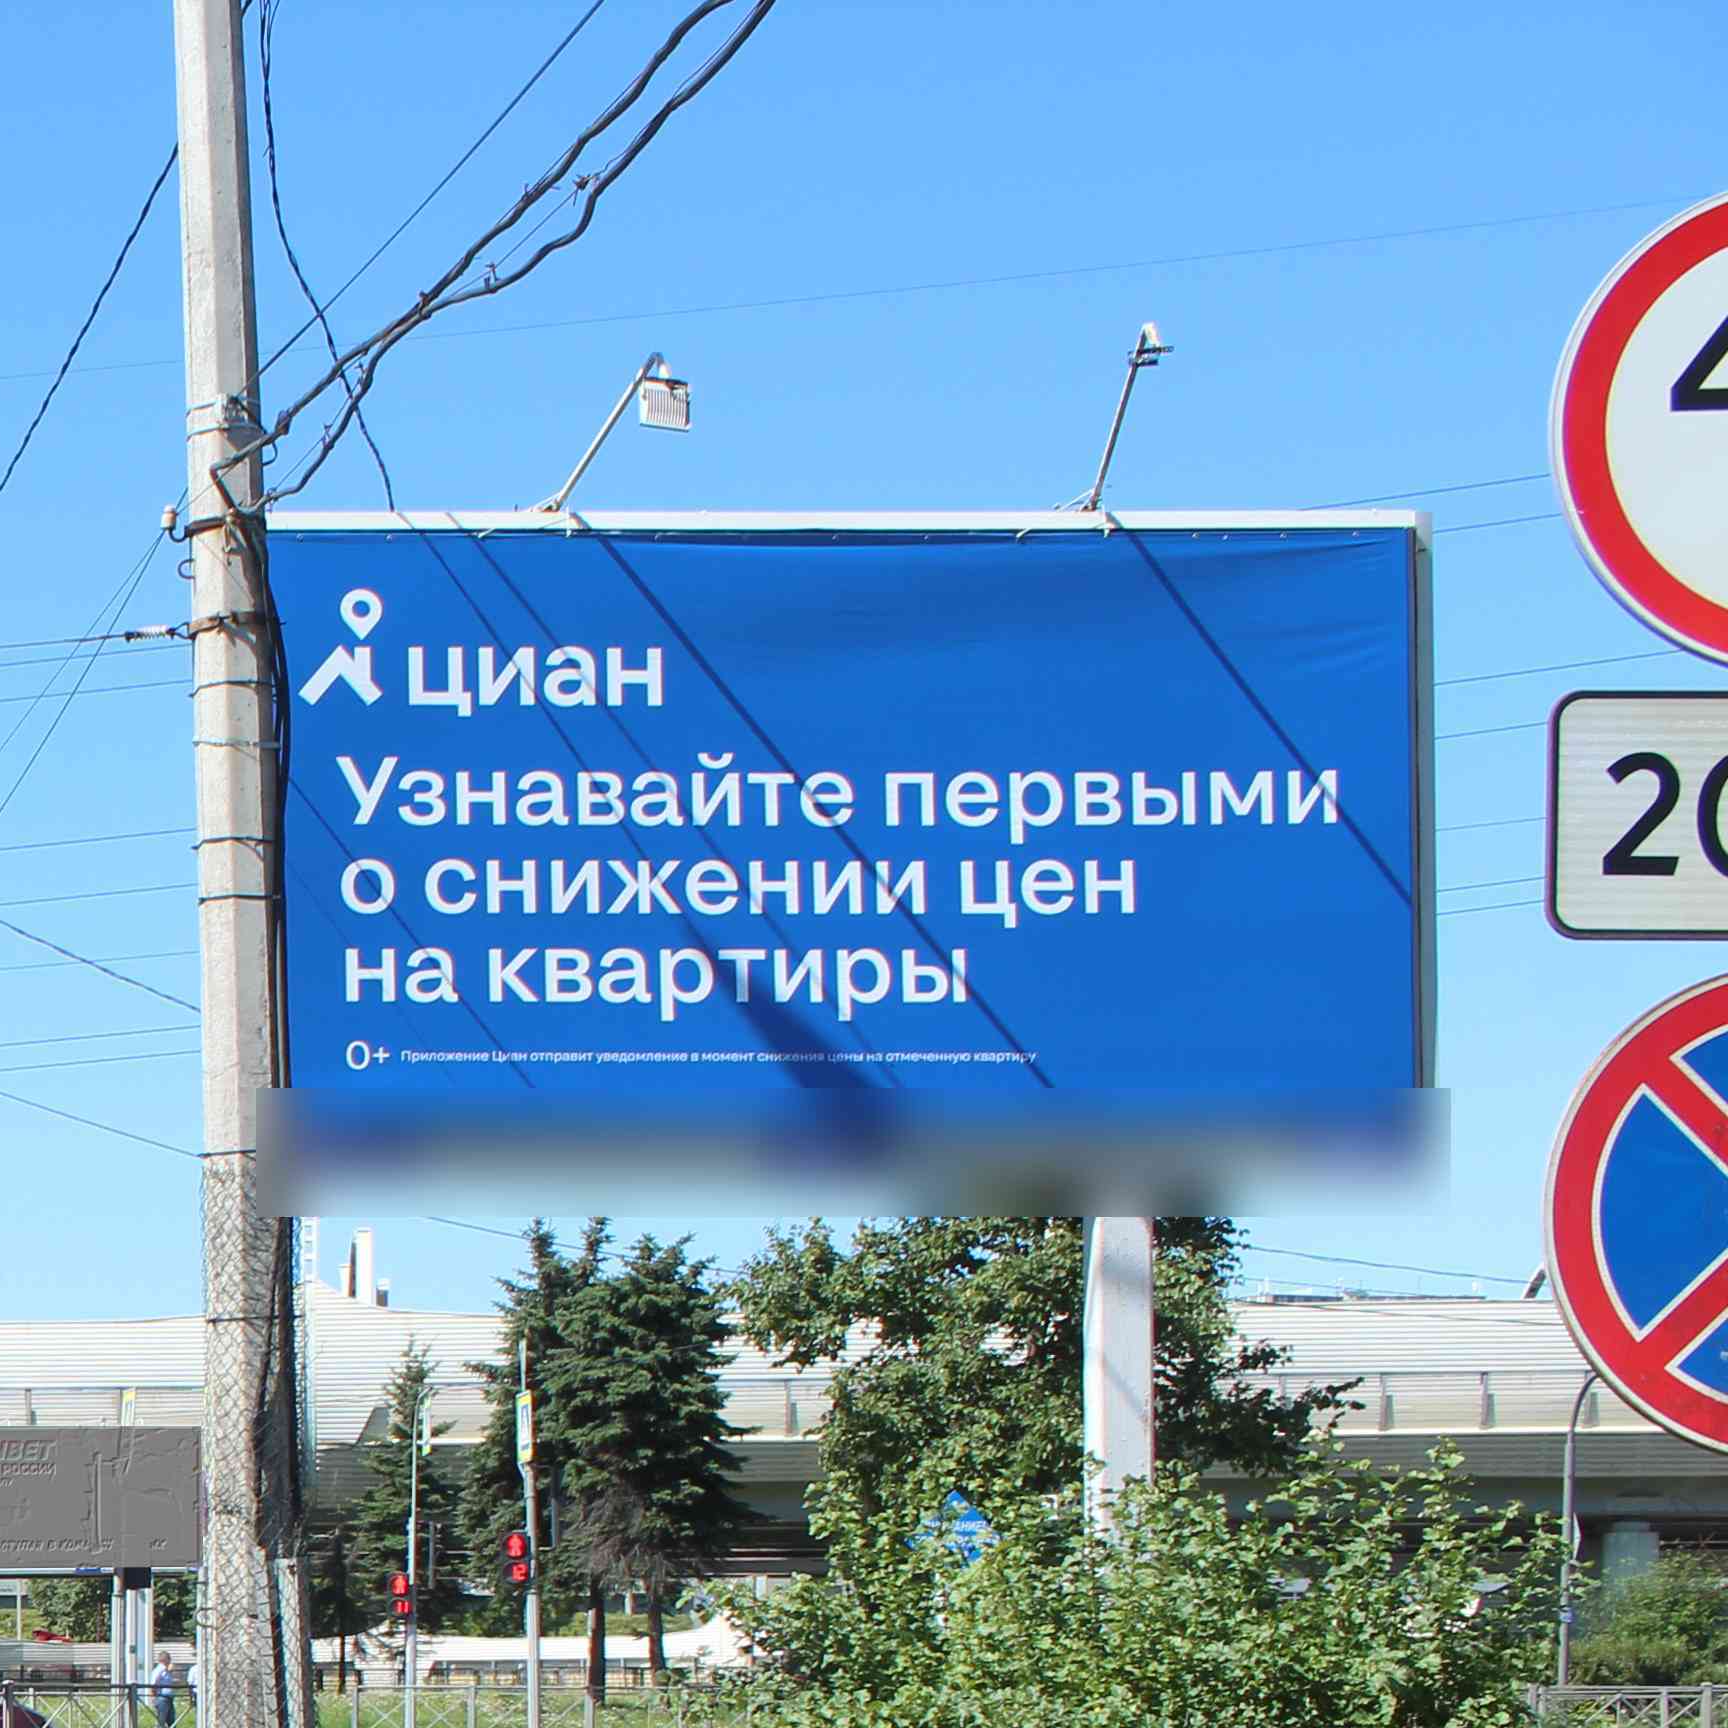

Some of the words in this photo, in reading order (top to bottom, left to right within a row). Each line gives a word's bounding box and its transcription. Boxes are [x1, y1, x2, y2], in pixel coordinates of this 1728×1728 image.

[408, 645, 663, 717] циан
[336, 752, 854, 827] Узнавайте
[885, 769, 1340, 845] первыми
[341, 858, 396, 914] о
[425, 858, 927, 915] снижении
[960, 859, 1136, 929] цен
[345, 947, 459, 1003] на
[488, 947, 968, 1022] квартиры
[345, 1040, 390, 1070] 0+
[400, 1050, 490, 1065] Приложение
[491, 1050, 528, 1065] Циан
[529, 1050, 593, 1065] отправит
[594, 1050, 688, 1065] уведомление
[690, 1053, 699, 1063] в
[701, 1051, 755, 1063] момент
[756, 1051, 825, 1064] снижения
[827, 1051, 864, 1066] цены
[866, 1053, 883, 1063] на
[884, 1051, 972, 1066] отмеченную
[973, 1051, 1037, 1066] квартиру
